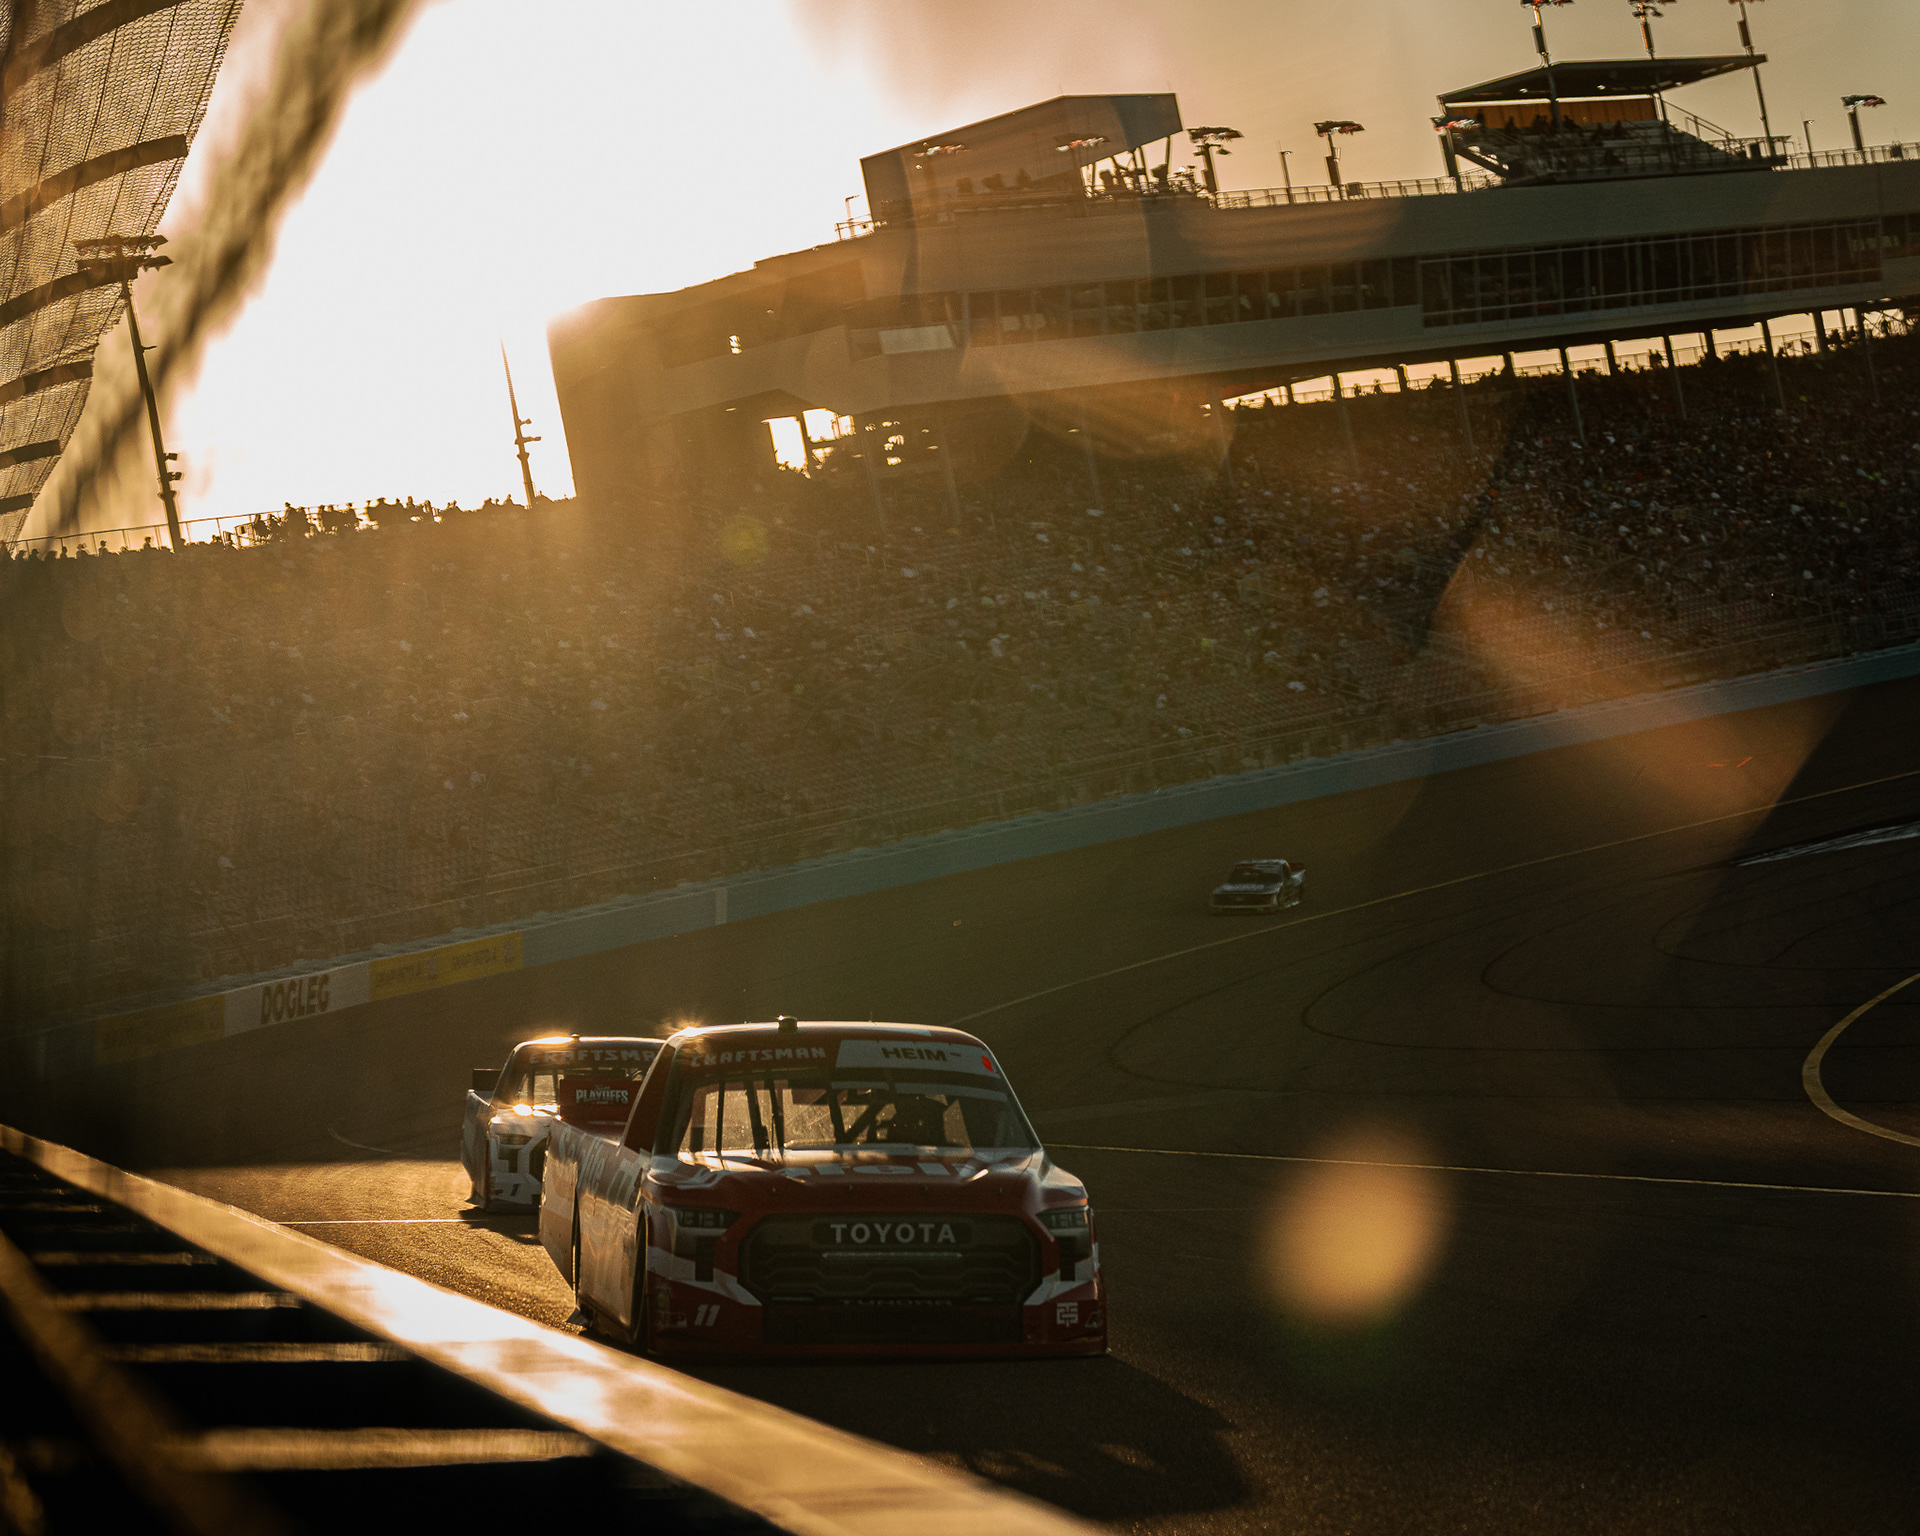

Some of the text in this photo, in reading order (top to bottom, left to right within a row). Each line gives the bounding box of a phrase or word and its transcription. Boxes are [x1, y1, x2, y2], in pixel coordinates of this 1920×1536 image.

[260, 974, 330, 1025] DOGLEG
[529, 1049, 657, 1064] CRAFTSMA
[690, 1047, 826, 1067] CRAFTSMAN
[881, 1047, 947, 1062] HEIM
[575, 1089, 629, 1105] PLAYOFFS
[830, 1223, 957, 1244] TOYOTA
[694, 1304, 721, 1327] 11
